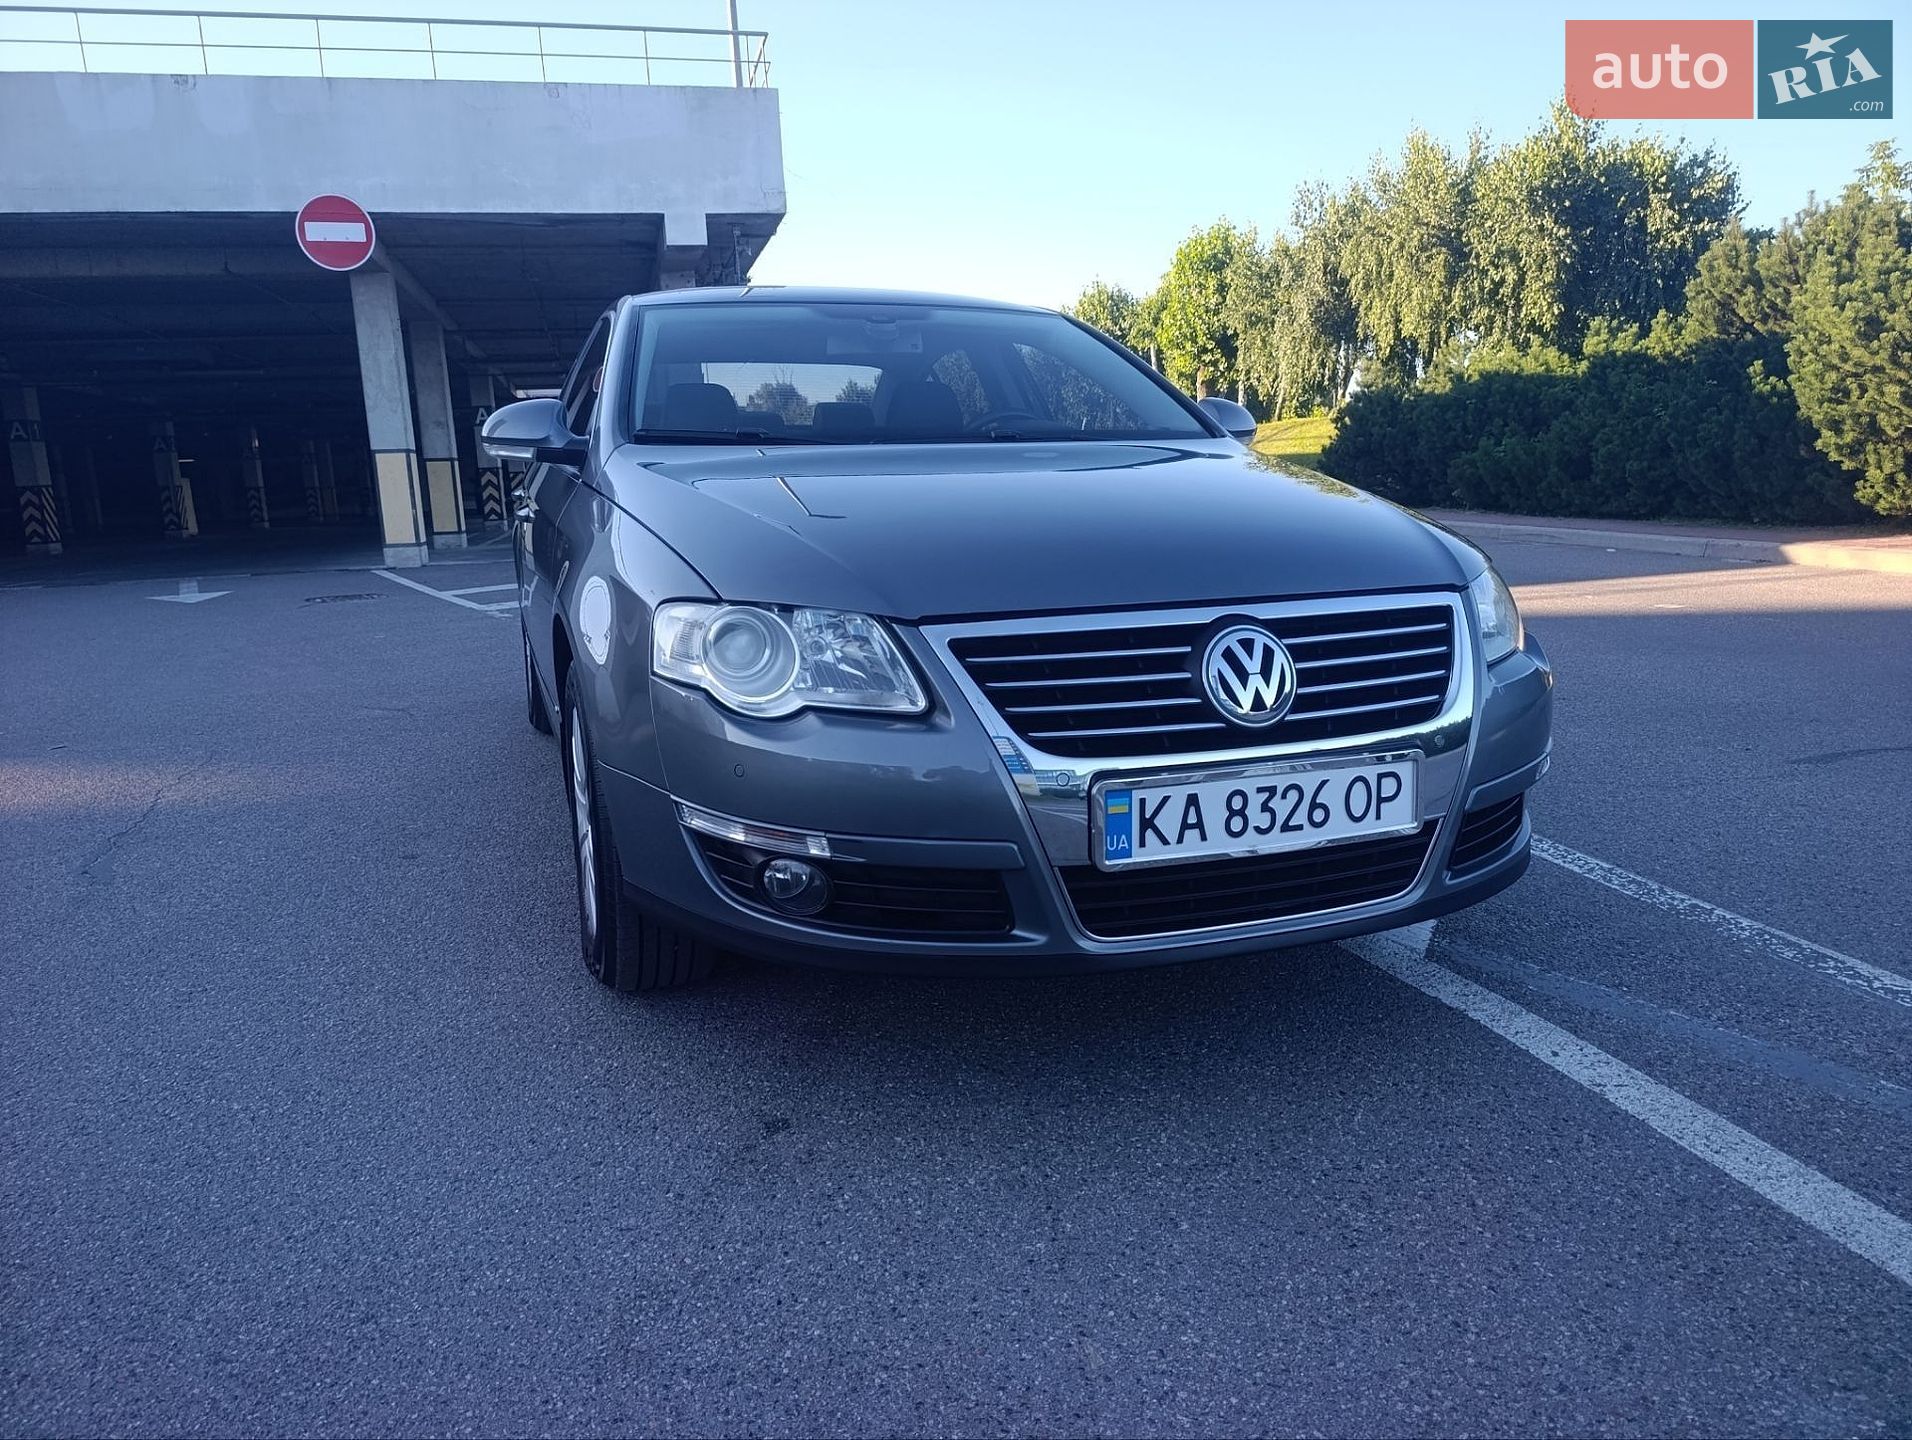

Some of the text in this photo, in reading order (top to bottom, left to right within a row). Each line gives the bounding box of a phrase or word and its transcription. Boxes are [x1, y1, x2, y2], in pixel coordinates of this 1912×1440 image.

[1208, 630, 1292, 715] VW
[1106, 834, 1130, 851] UA
[1138, 771, 1403, 849] KA 8326 OP
